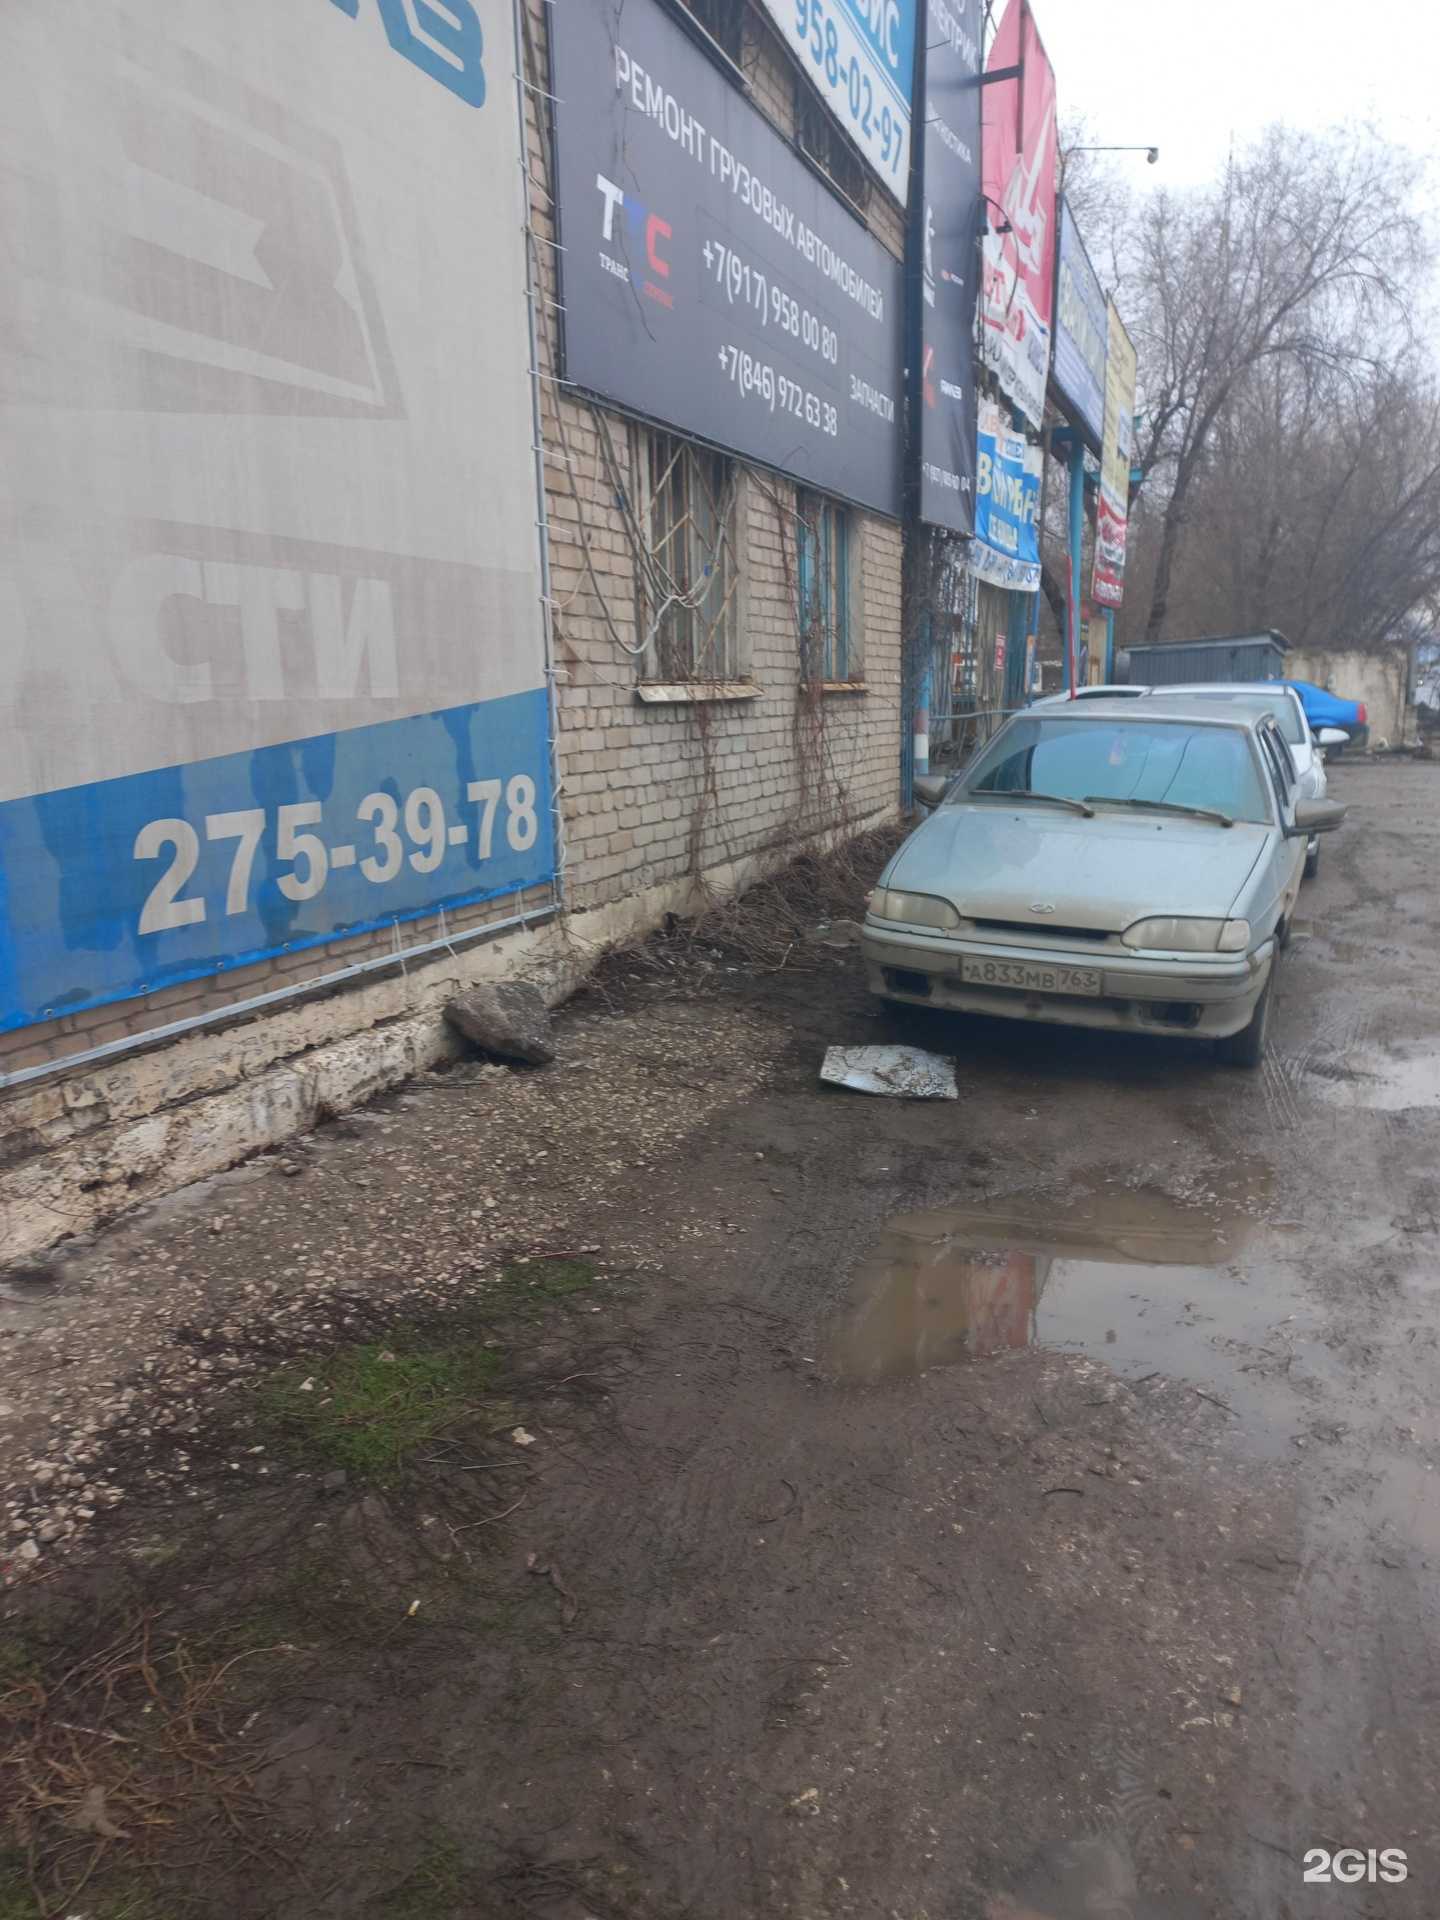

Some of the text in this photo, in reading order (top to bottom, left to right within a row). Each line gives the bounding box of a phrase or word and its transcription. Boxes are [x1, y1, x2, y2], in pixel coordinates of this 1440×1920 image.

[796, 0, 903, 174] 958-02-97
[614, 44, 706, 163] РЕМОНТ
[710, 136, 795, 245] ГРУЗОВЫХ
[797, 223, 883, 323] АВТОМОБИЛЕЙ
[703, 240, 768, 326] +7(917)
[771, 286, 799, 337] 958
[802, 310, 819, 351] 00
[822, 326, 837, 364] 80
[718, 345, 837, 436] +7(846) 972 63 38
[849, 374, 894, 423] ЗАПЧАСТИ
[133, 774, 538, 936] 275-39-78
[1060, 970, 1097, 988] 763
